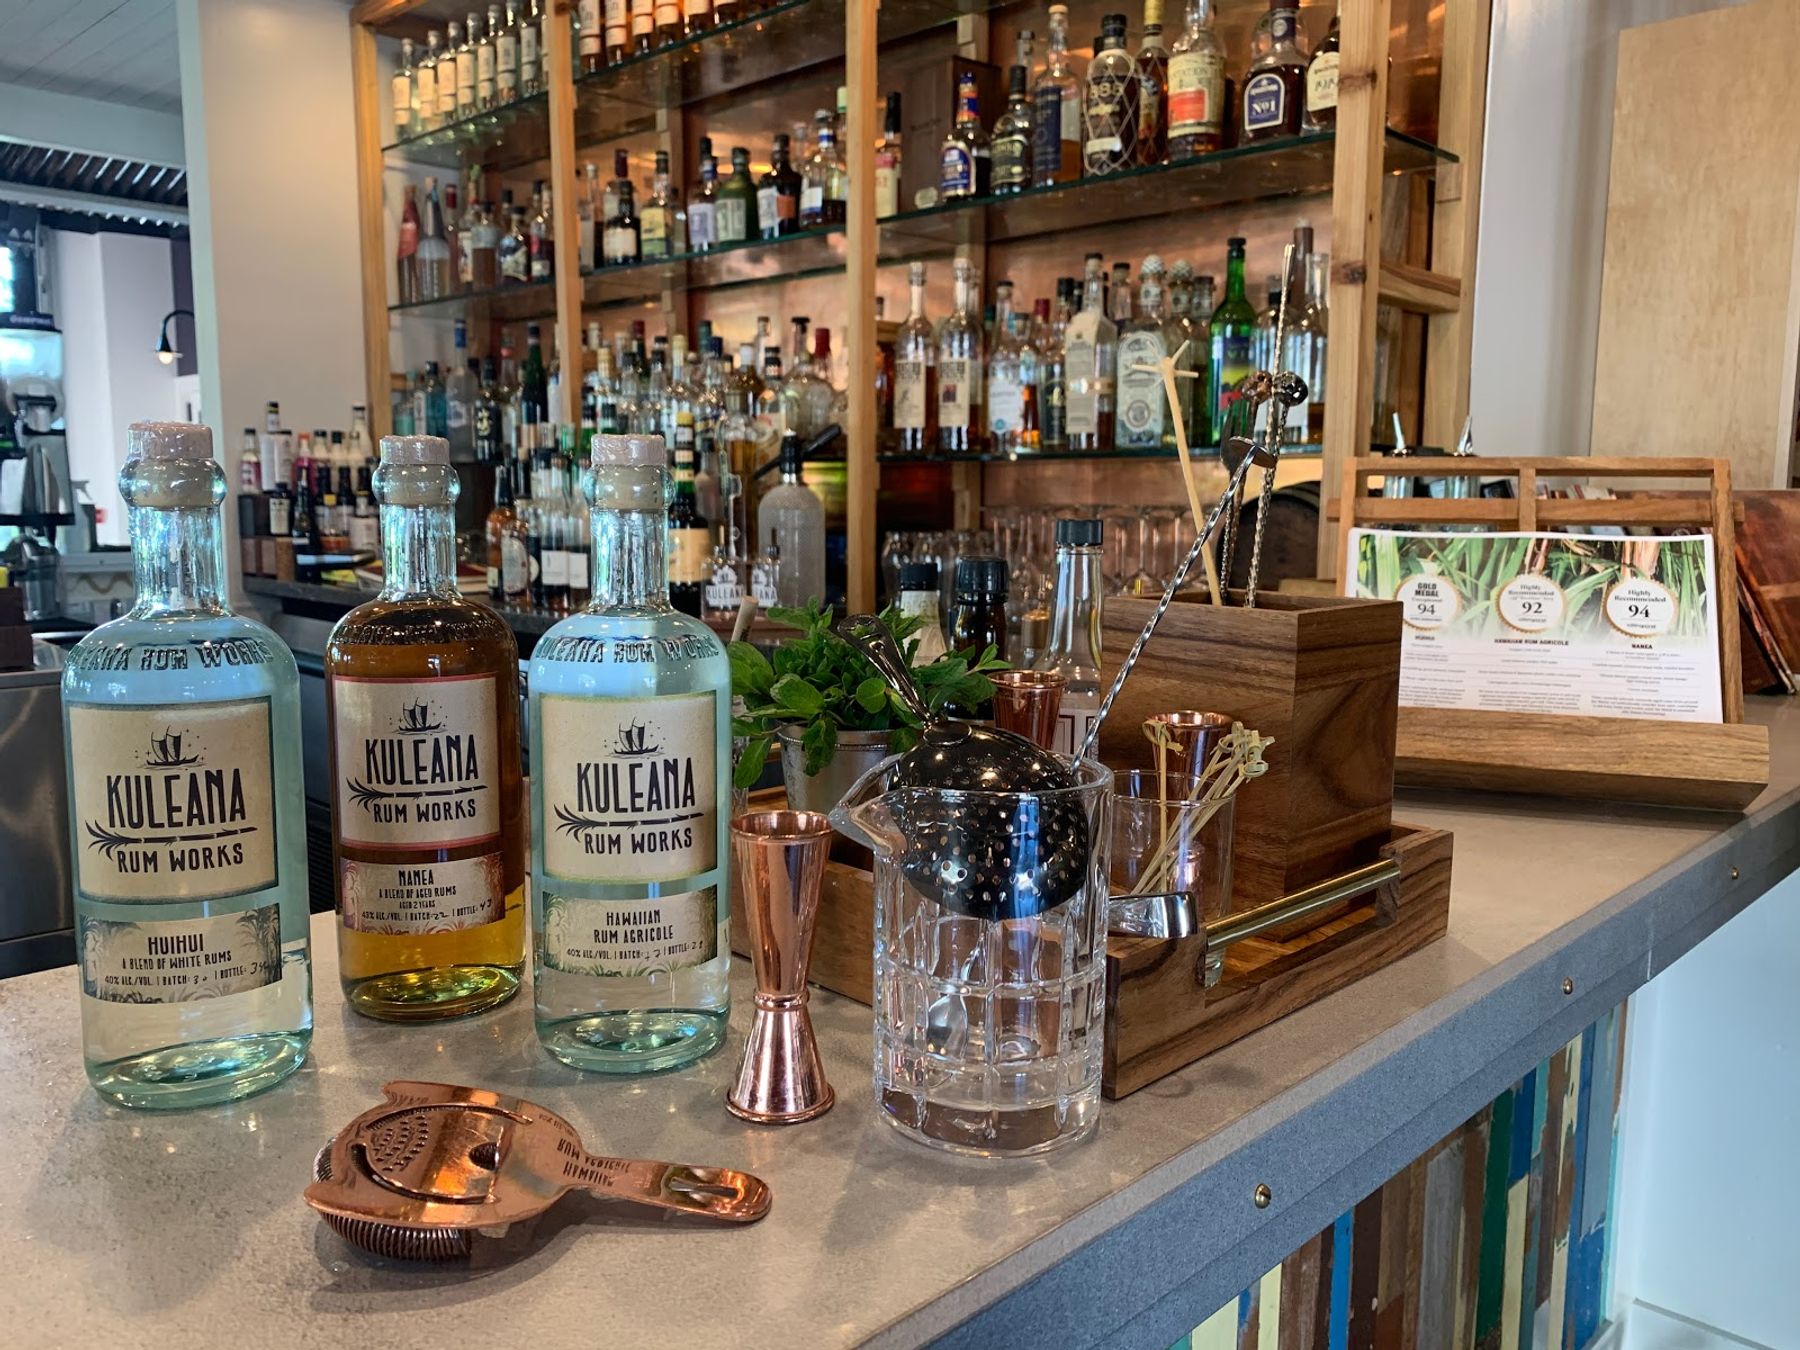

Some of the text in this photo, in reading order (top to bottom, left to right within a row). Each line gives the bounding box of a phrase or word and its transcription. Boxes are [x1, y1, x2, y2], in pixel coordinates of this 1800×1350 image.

[1415, 589, 1439, 598] MEDAL
[1417, 582, 1437, 590] GOLD
[1627, 589, 1651, 597] Highly
[1417, 603, 1436, 615] 94
[1522, 602, 1543, 615] 92
[1628, 604, 1650, 618] 94
[364, 734, 479, 786] KULEANA
[577, 757, 696, 814] KULEANA
[106, 768, 246, 830] KULEANA
[373, 799, 477, 824] RUM WORKS
[584, 827, 693, 855] RUM WORKS
[117, 842, 244, 874] RUM WORKS
[384, 888, 405, 899] BLEND
[406, 888, 414, 898] OF
[416, 887, 432, 898] AGED
[434, 885, 457, 897] RUMS
[606, 909, 661, 926] HAWAIIAN
[148, 933, 205, 955] HUIHUI
[594, 925, 673, 944] RUM AGRICOLE
[129, 957, 154, 970] BLEND
[157, 957, 166, 970] OF
[169, 955, 201, 970] WHITE
[204, 950, 232, 965] RUMS
